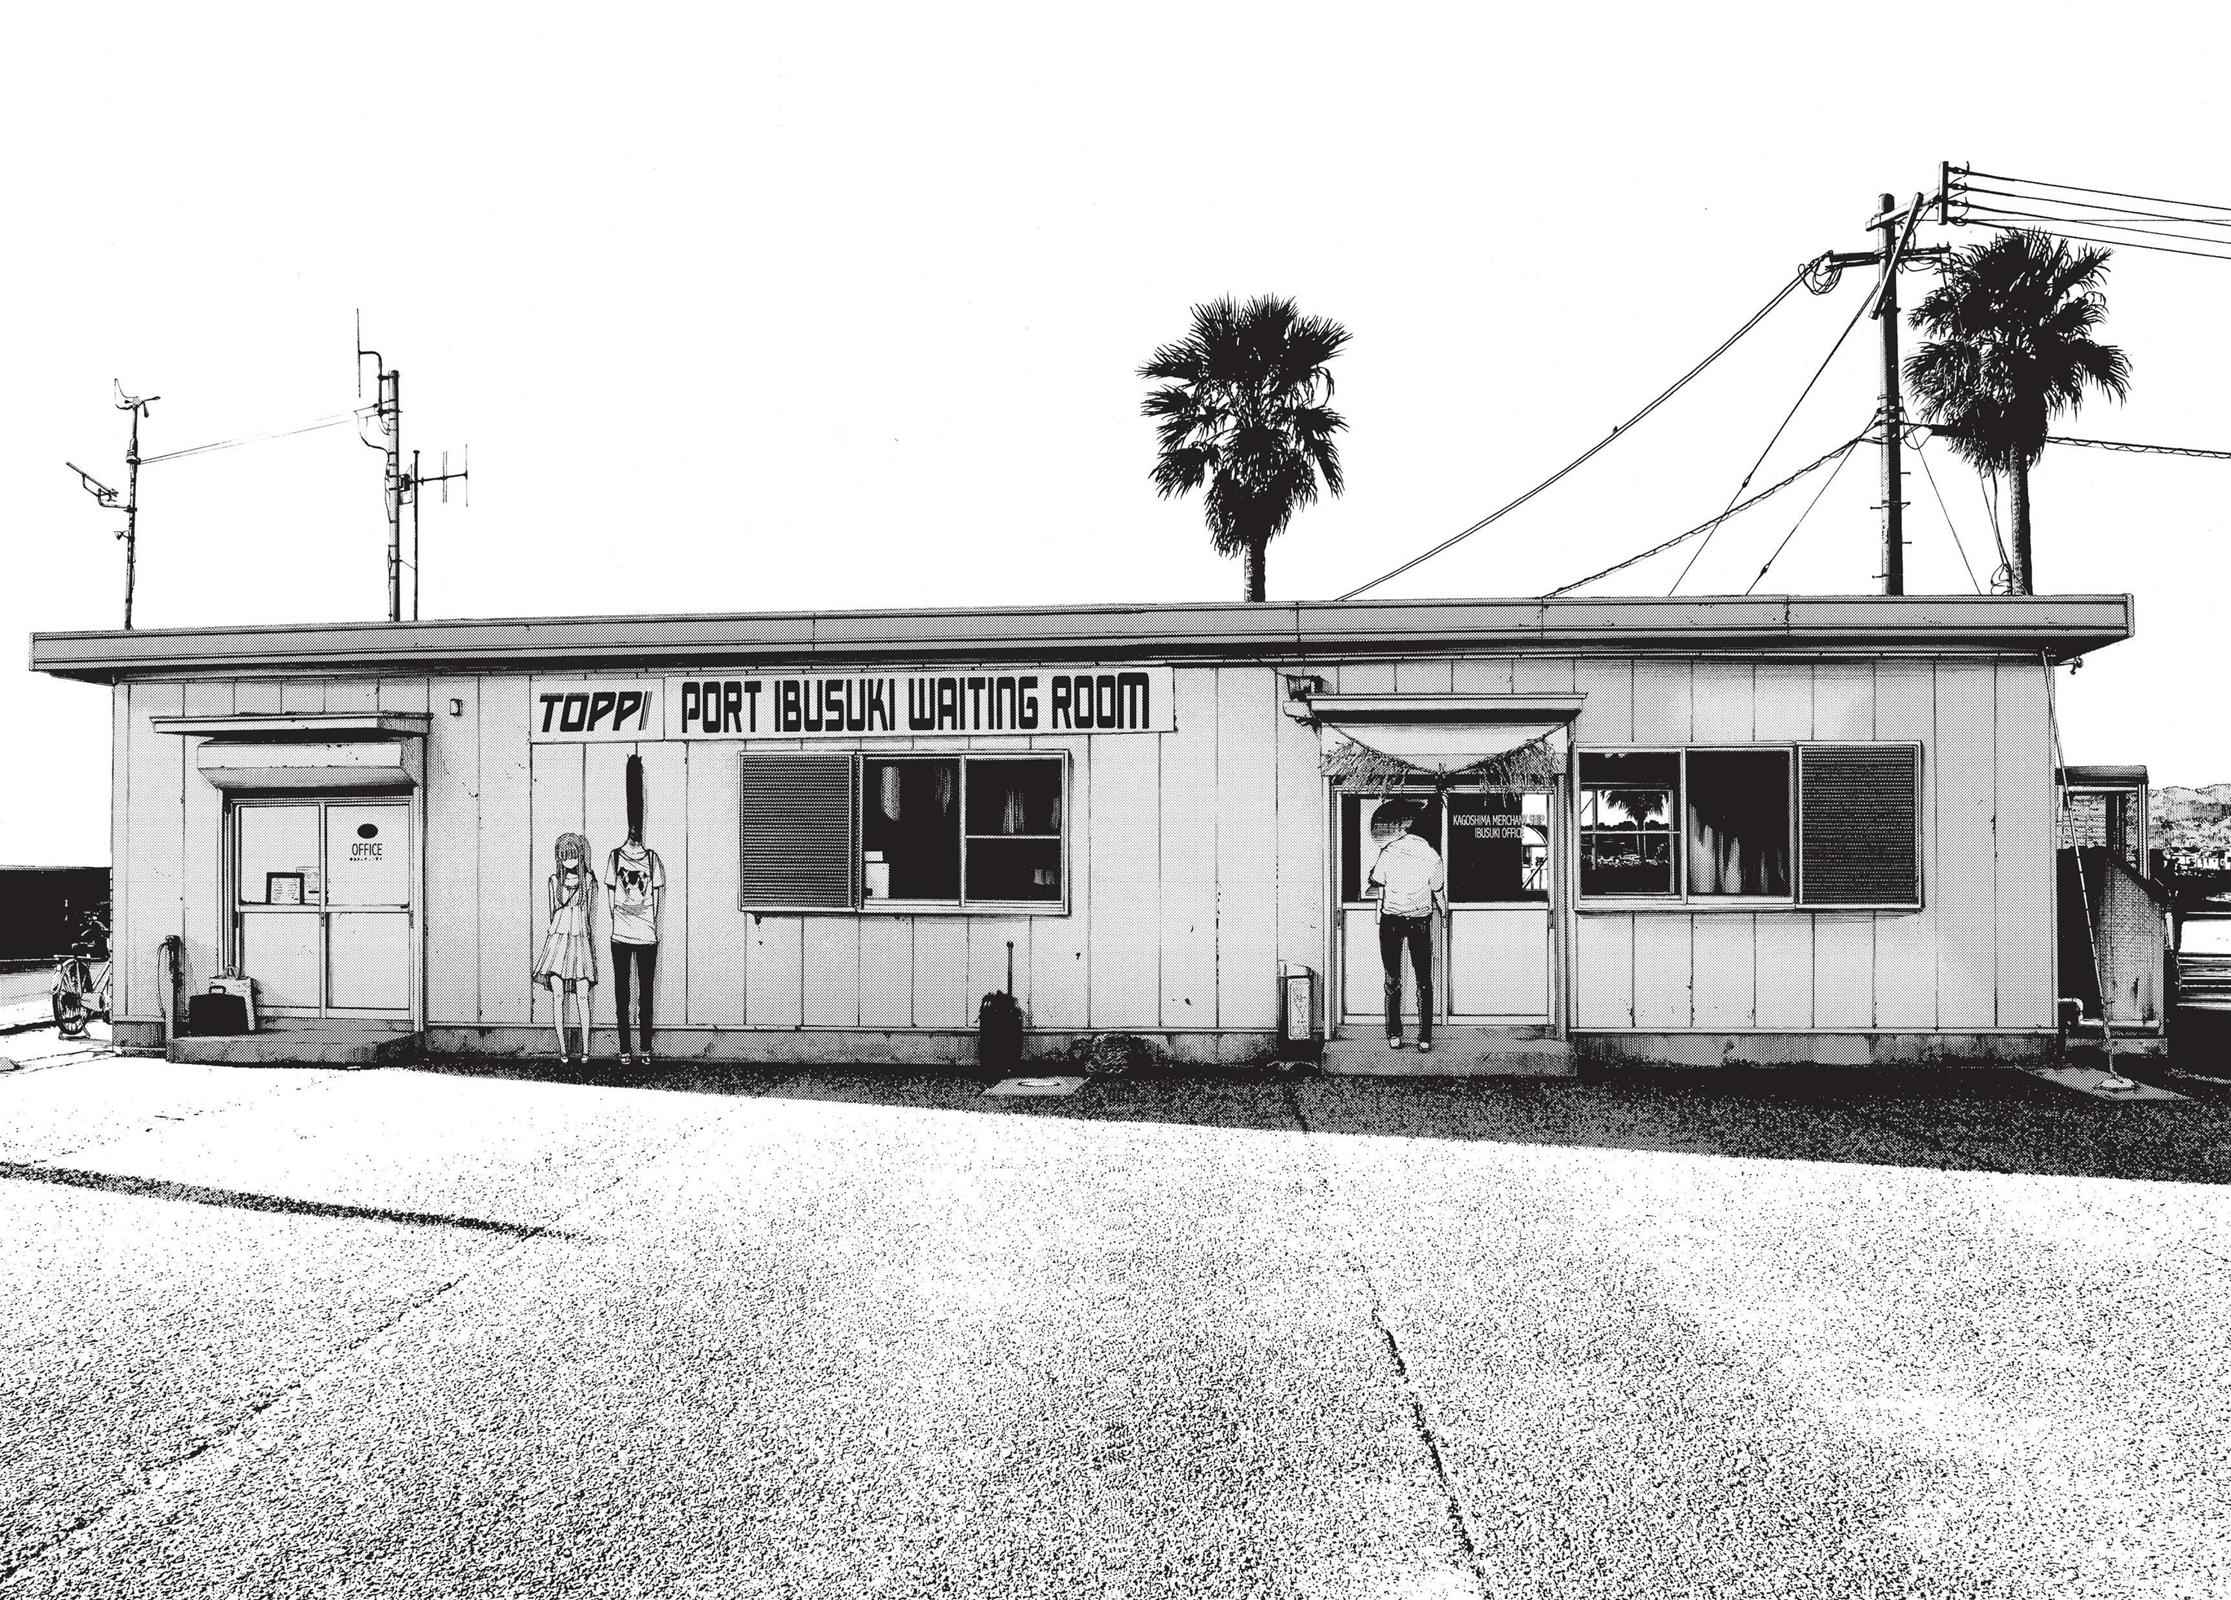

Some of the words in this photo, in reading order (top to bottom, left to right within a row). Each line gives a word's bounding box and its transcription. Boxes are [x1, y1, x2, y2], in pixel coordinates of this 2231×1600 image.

[682, 681, 762, 733] PORT
[774, 677, 896, 733] IBUSUKI
[908, 676, 1039, 731] WAITING
[1051, 672, 1150, 729] ROOM
[1452, 814, 1491, 826] KAGOSHIMA
[1474, 827, 1501, 839] IBUSUKI
[352, 843, 383, 856] OFFICE
